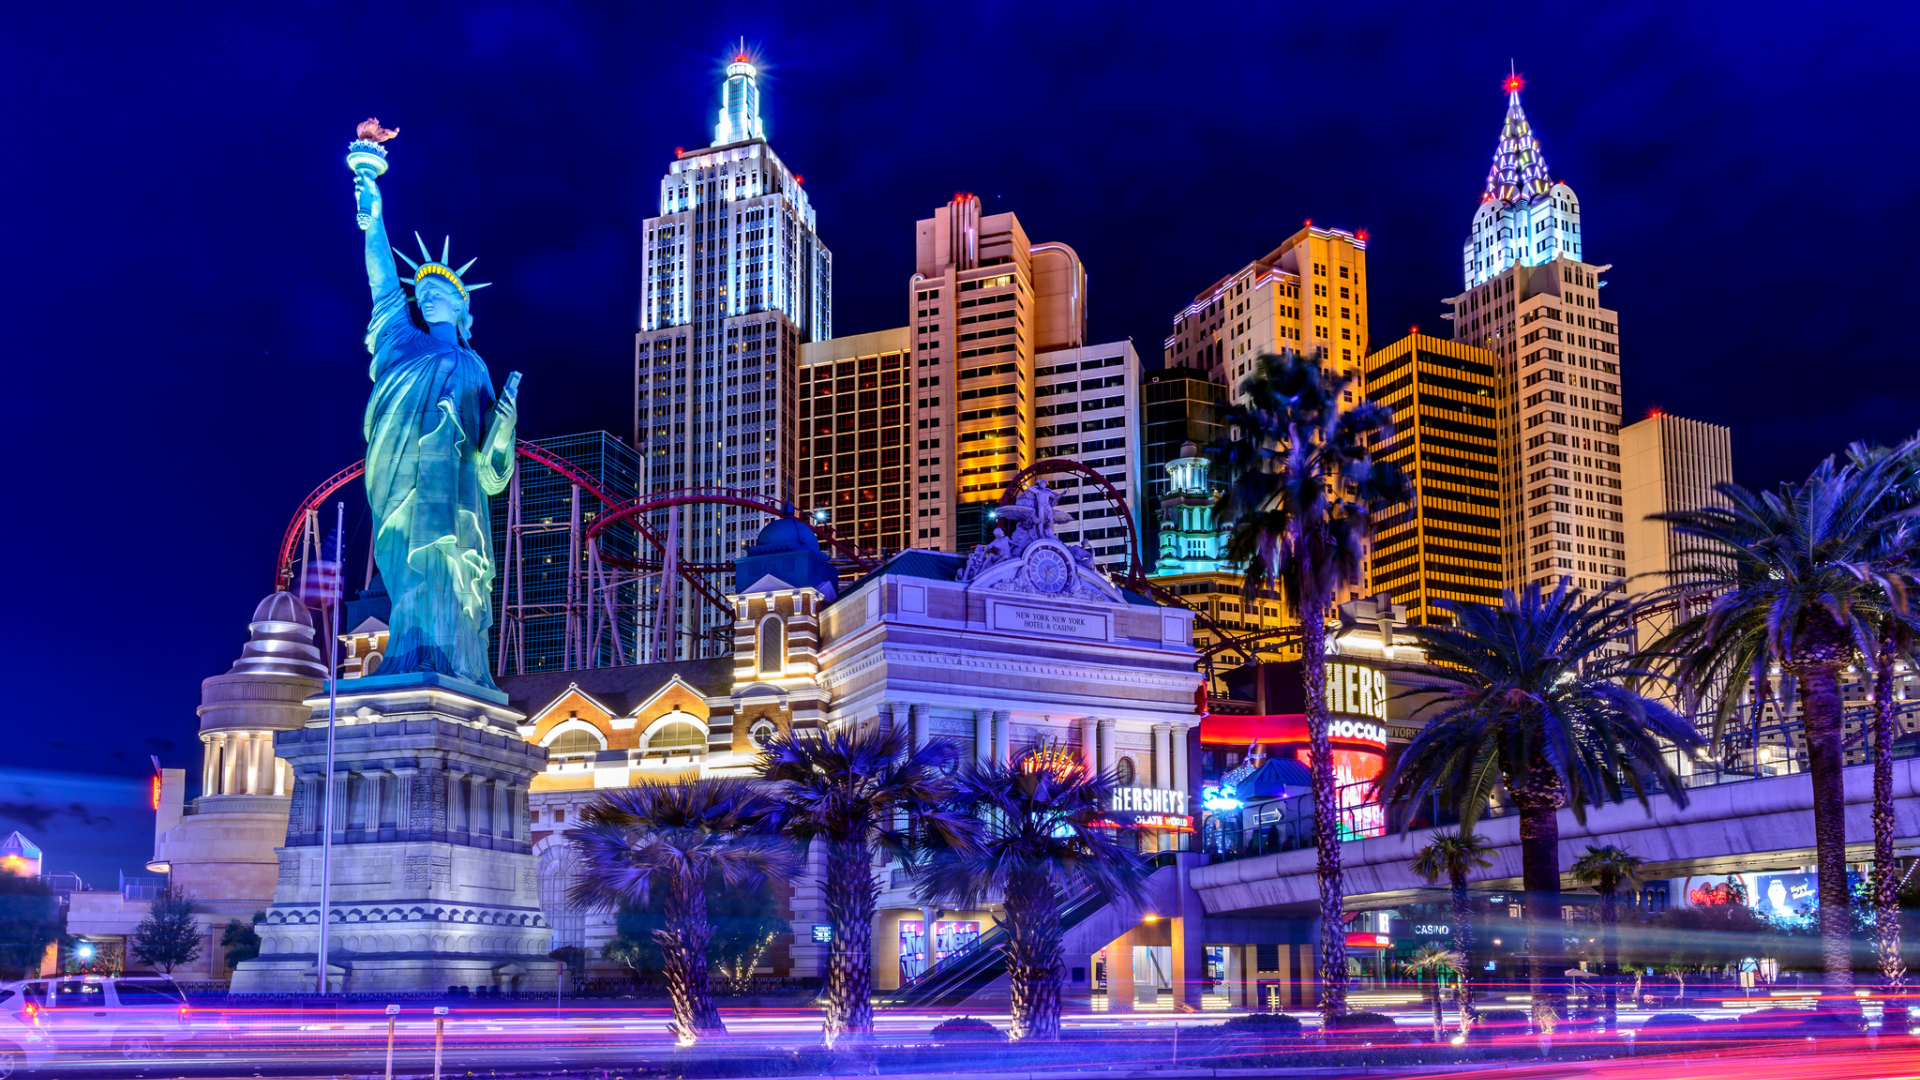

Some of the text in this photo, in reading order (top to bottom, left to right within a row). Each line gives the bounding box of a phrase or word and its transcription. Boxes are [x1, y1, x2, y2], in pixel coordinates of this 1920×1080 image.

[1016, 611, 1086, 626] NEW YORK NEW YORK
[1024, 620, 1044, 629] HOTEL
[1052, 623, 1076, 632] CASINO
[1164, 816, 1188, 827] WORLD
[1415, 924, 1450, 935] CASINO
